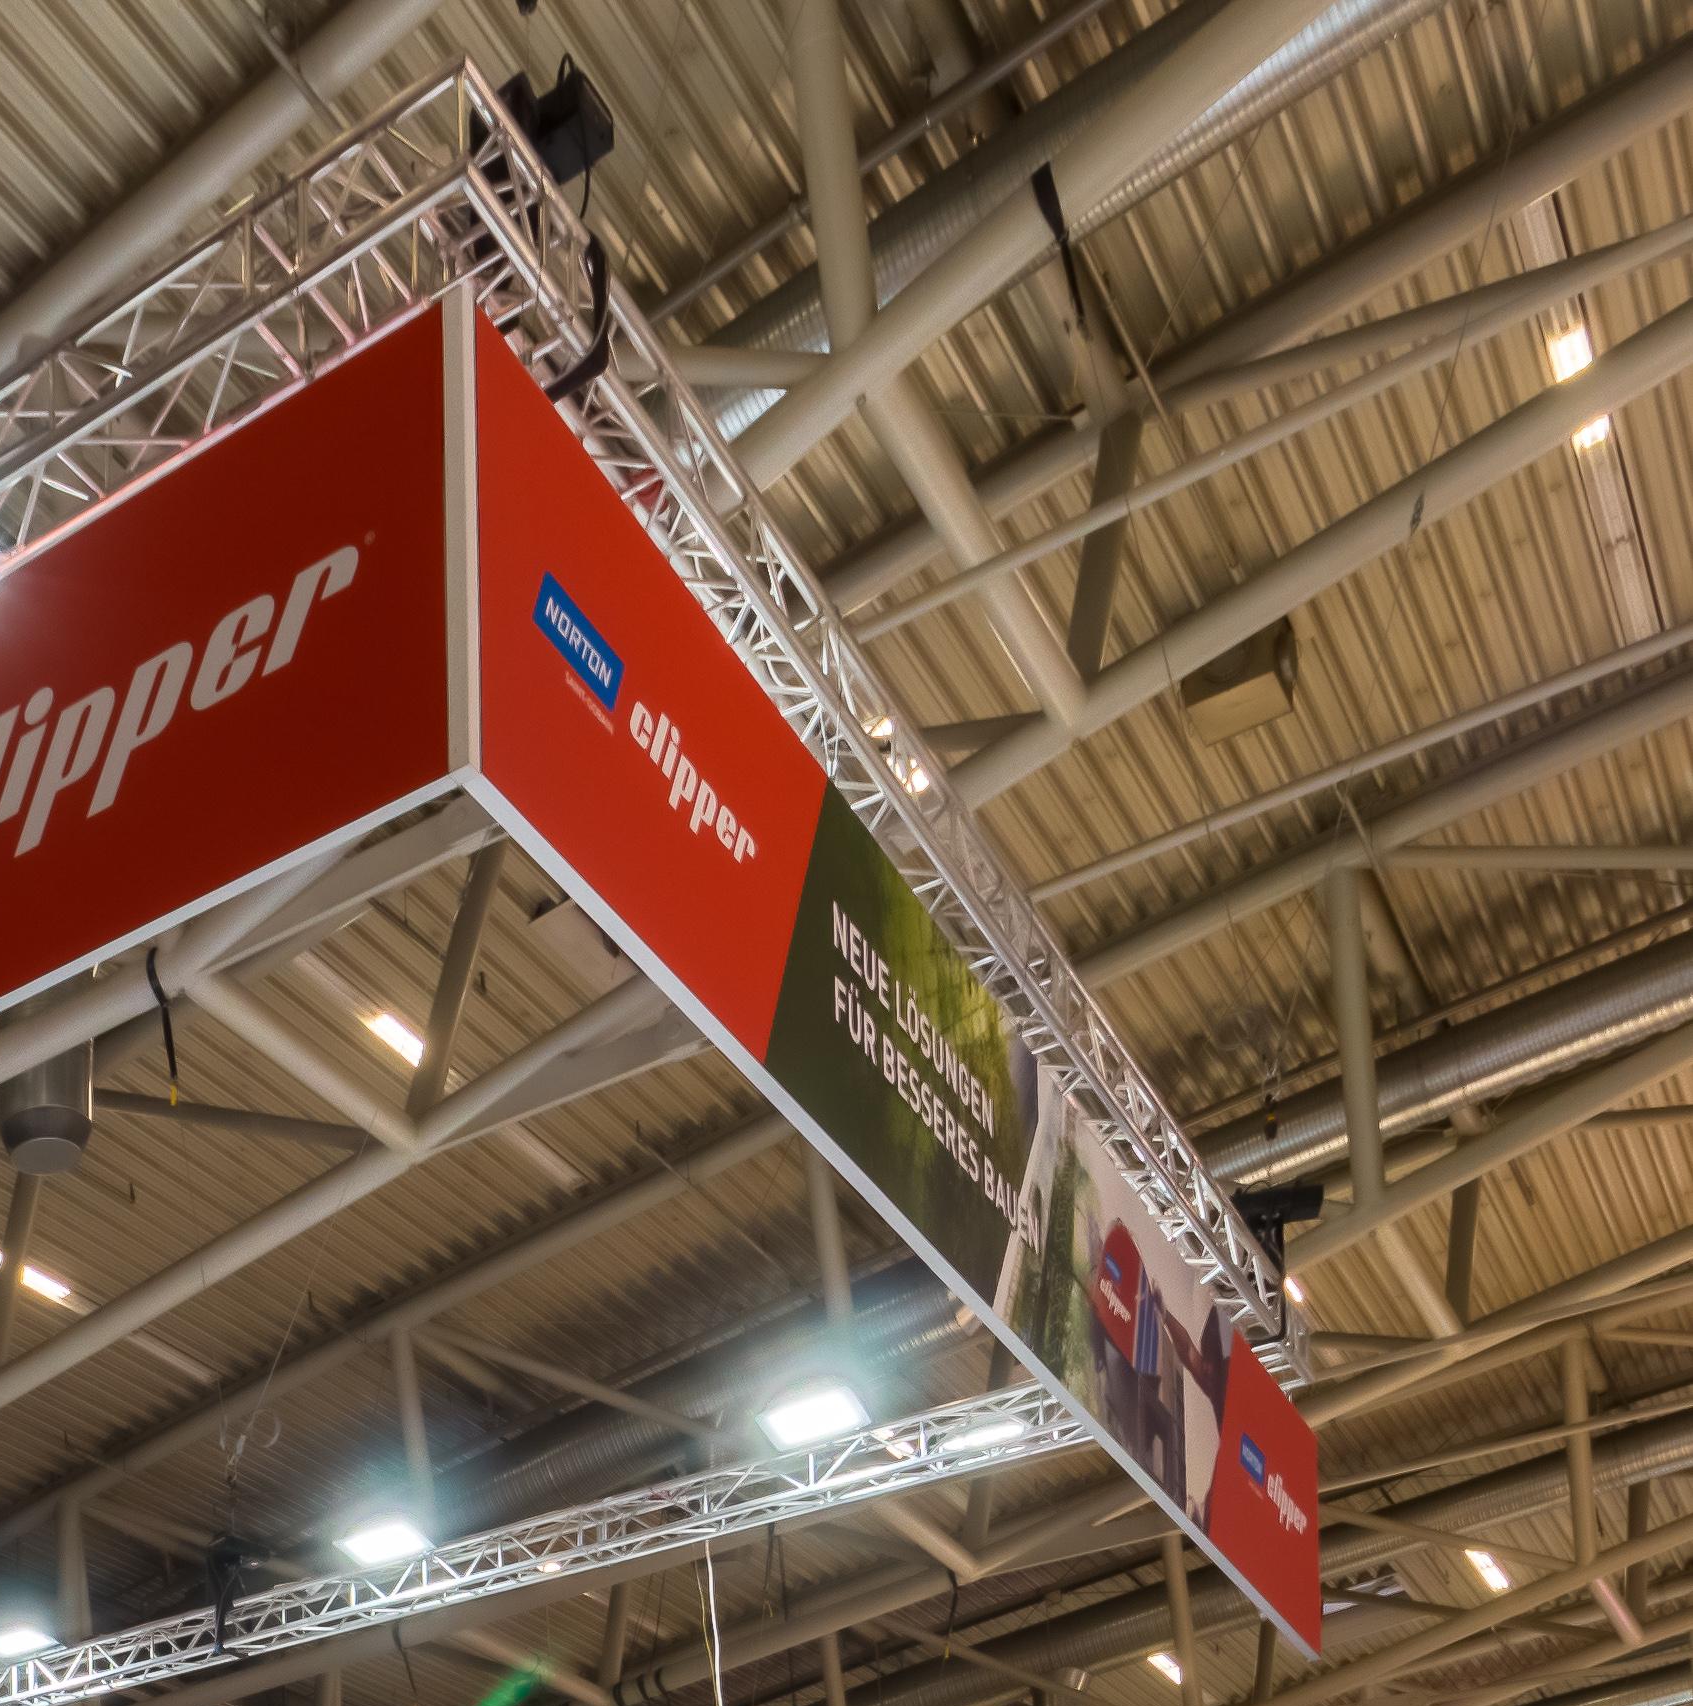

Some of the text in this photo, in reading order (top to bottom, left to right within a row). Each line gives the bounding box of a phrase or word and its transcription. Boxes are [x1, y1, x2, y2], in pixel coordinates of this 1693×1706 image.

[545, 597, 612, 689] NORTON
[629, 700, 757, 864] clipper
[833, 900, 994, 1138] NEUE LÖSUNGEN
[834, 975, 1041, 1255] FÜR BESSERES BAUEN
